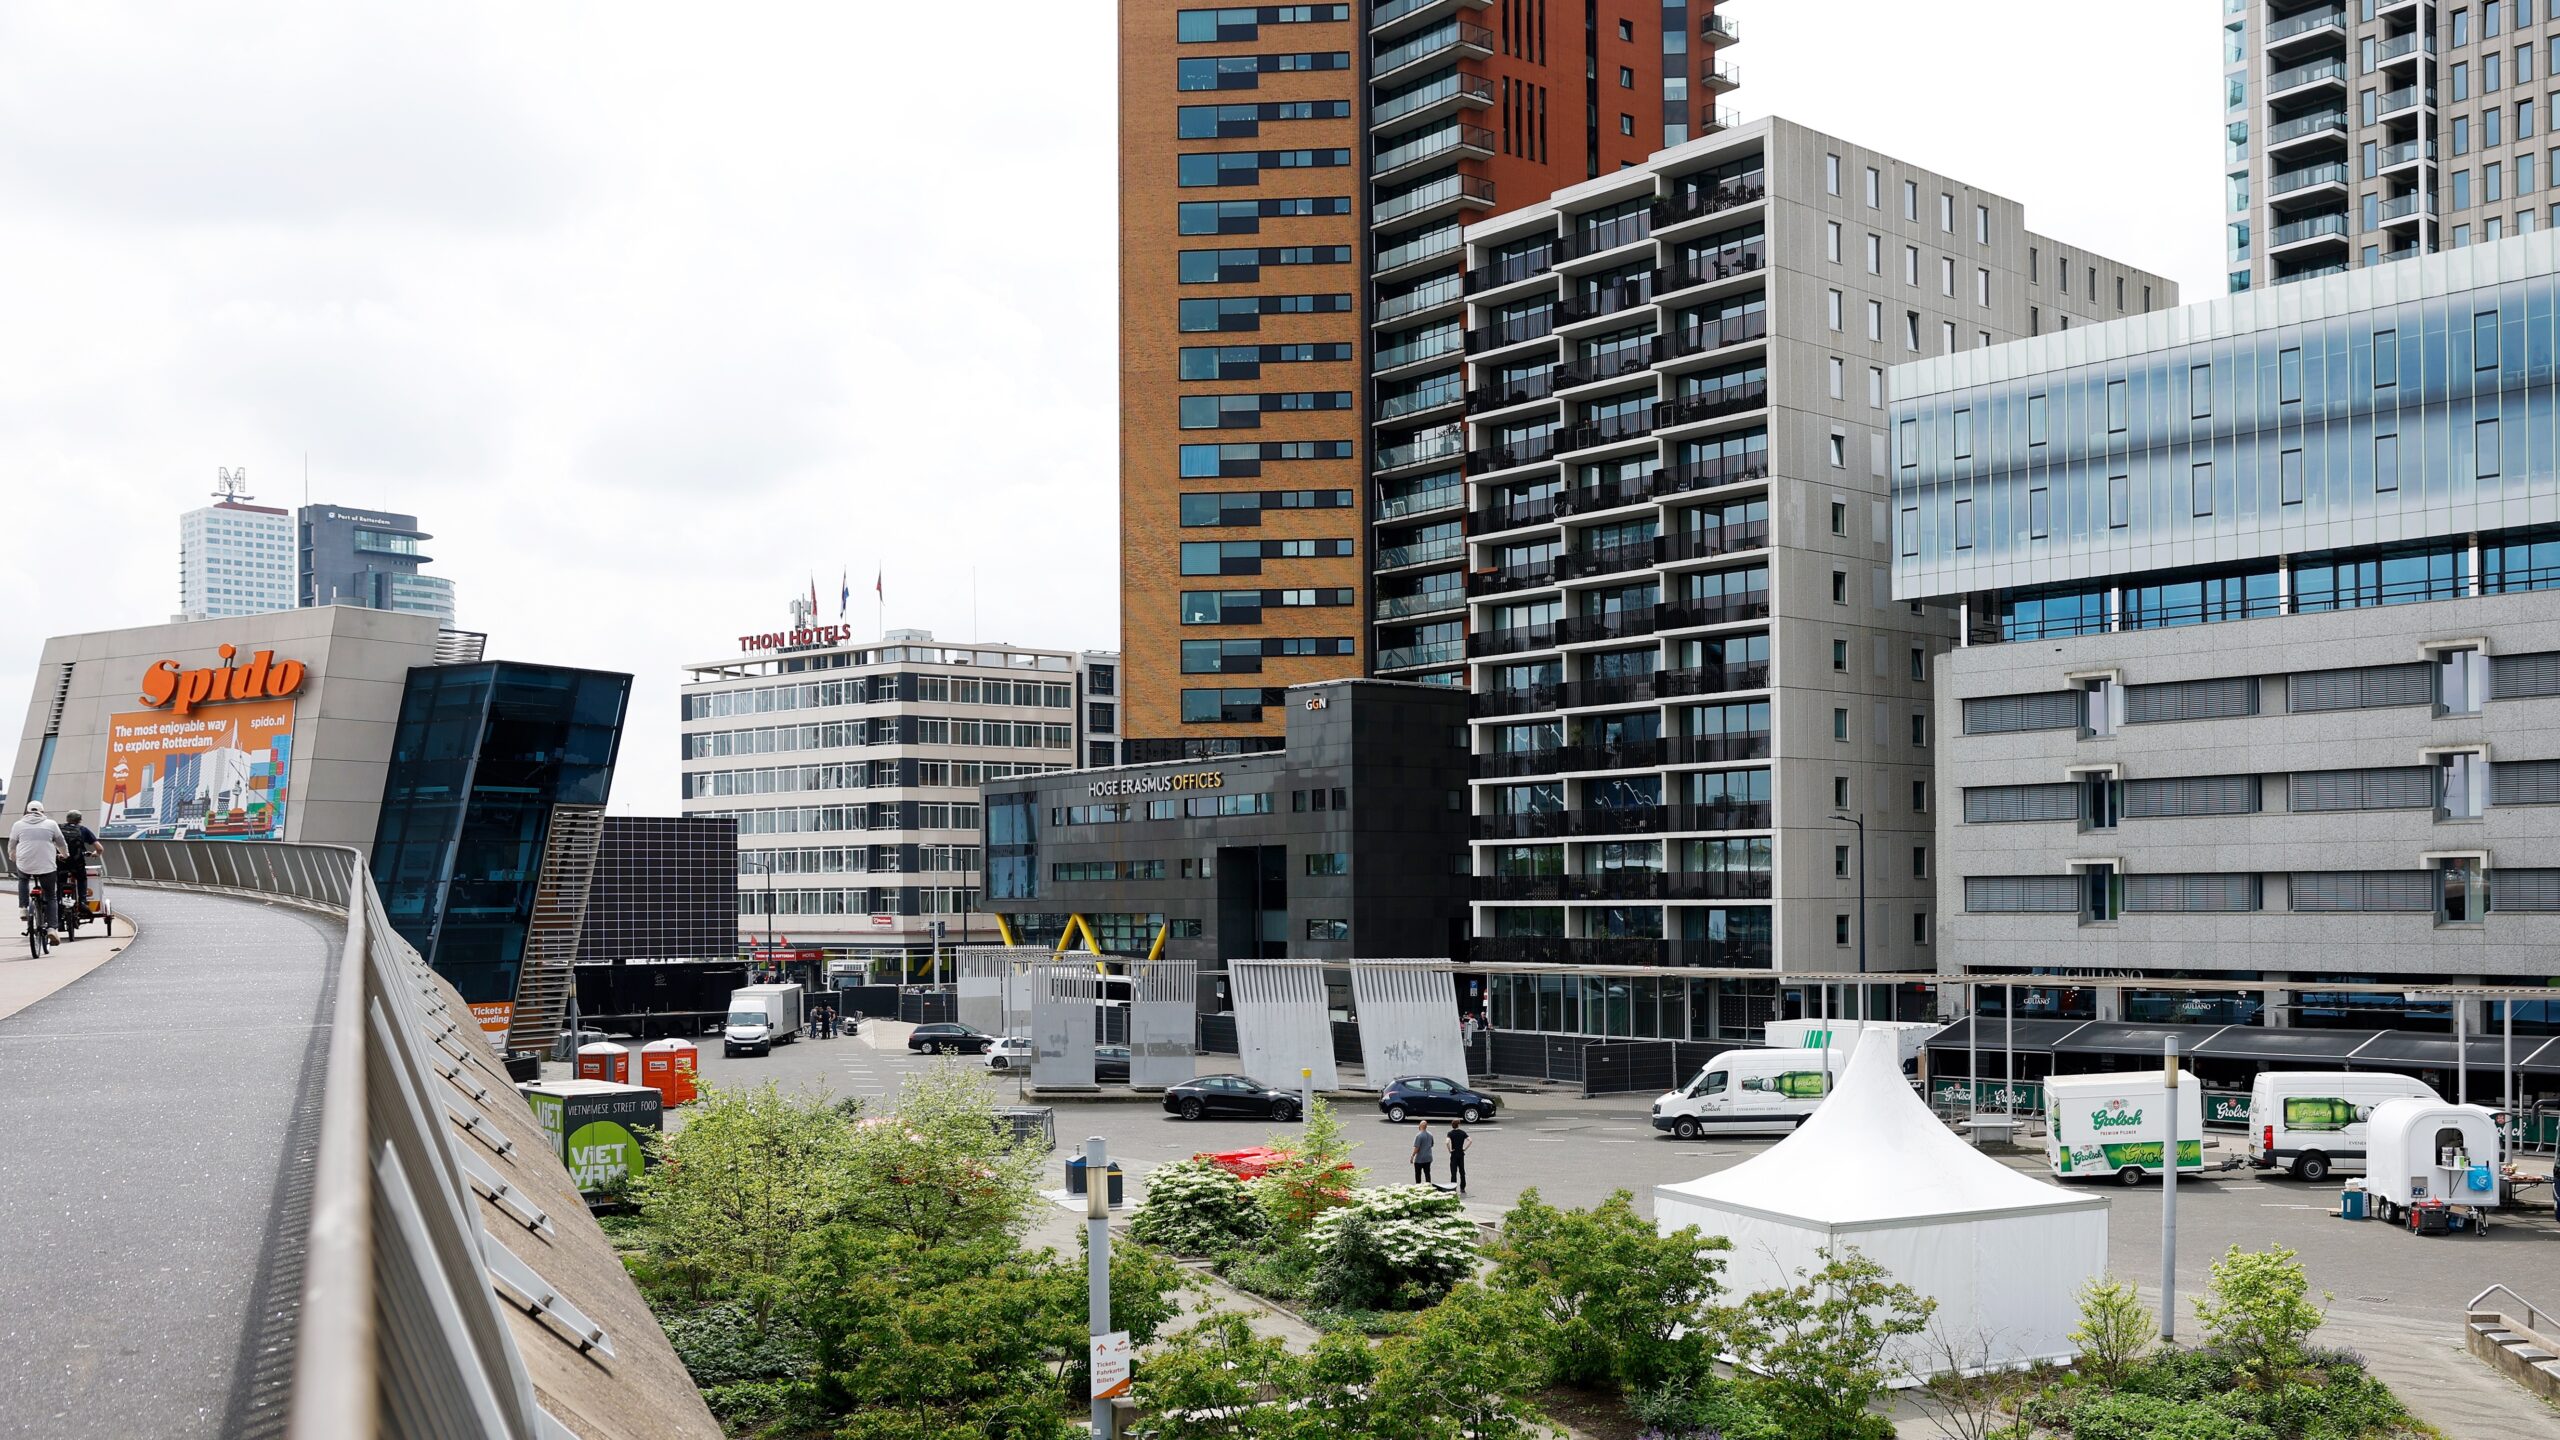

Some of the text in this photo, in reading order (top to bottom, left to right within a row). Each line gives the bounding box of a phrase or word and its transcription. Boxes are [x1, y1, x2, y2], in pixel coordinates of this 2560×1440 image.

[219, 467, 245, 492] M
[337, 513, 351, 521] Port
[359, 516, 391, 525] Rotterdam
[739, 624, 851, 652] THON HOTELS
[139, 643, 305, 715] Spido
[1306, 698, 1327, 710] GGN
[115, 720, 227, 737] The most enjoyable way
[251, 715, 285, 729] spido.nl
[113, 735, 213, 753] to explore Rotterdam
[1088, 771, 1223, 797] HOGE ERASMUS OFFICES
[473, 1005, 510, 1016] Tickets &
[568, 1100, 657, 1116] VIETNAMESE STREET FOOD
[2091, 1109, 2143, 1131] Grolsch
[2072, 1149, 2103, 1166] Grolsch
